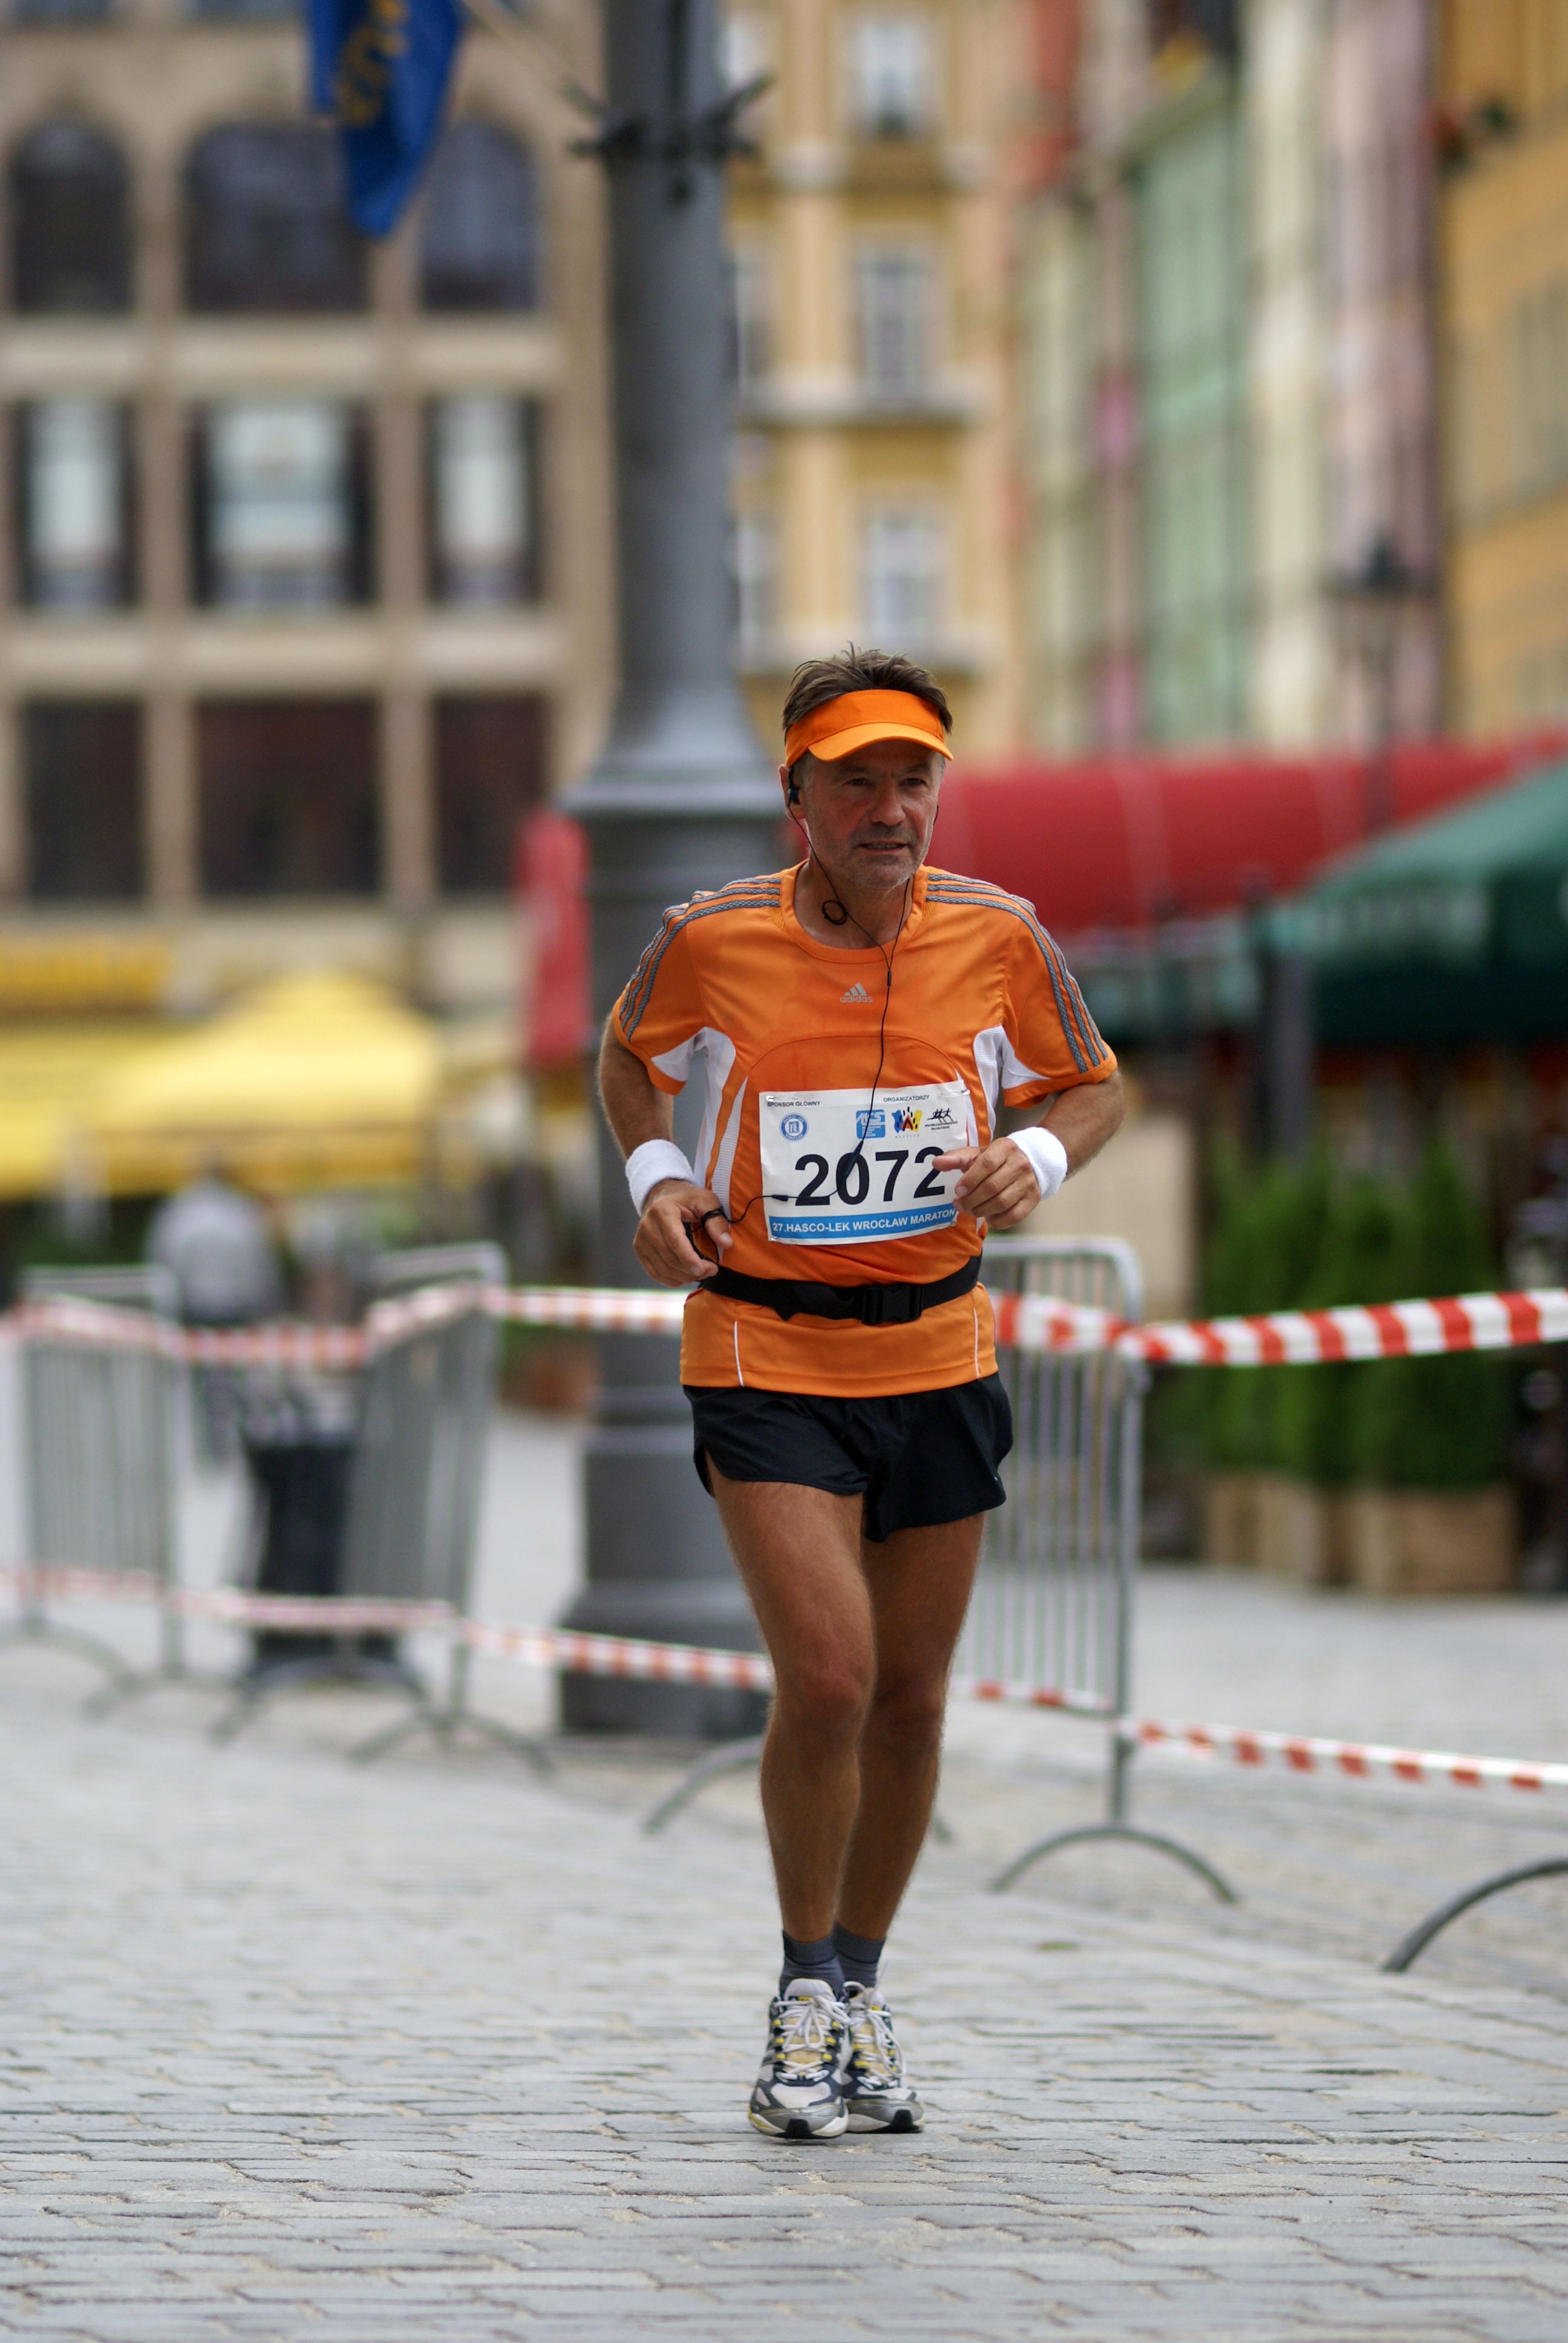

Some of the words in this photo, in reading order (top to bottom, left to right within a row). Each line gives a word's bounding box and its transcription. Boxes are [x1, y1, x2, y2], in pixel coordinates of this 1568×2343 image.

[794, 1146, 946, 1206] 2072
[852, 1217, 908, 1230] WROCŁAW
[909, 1208, 955, 1224] MARATON
